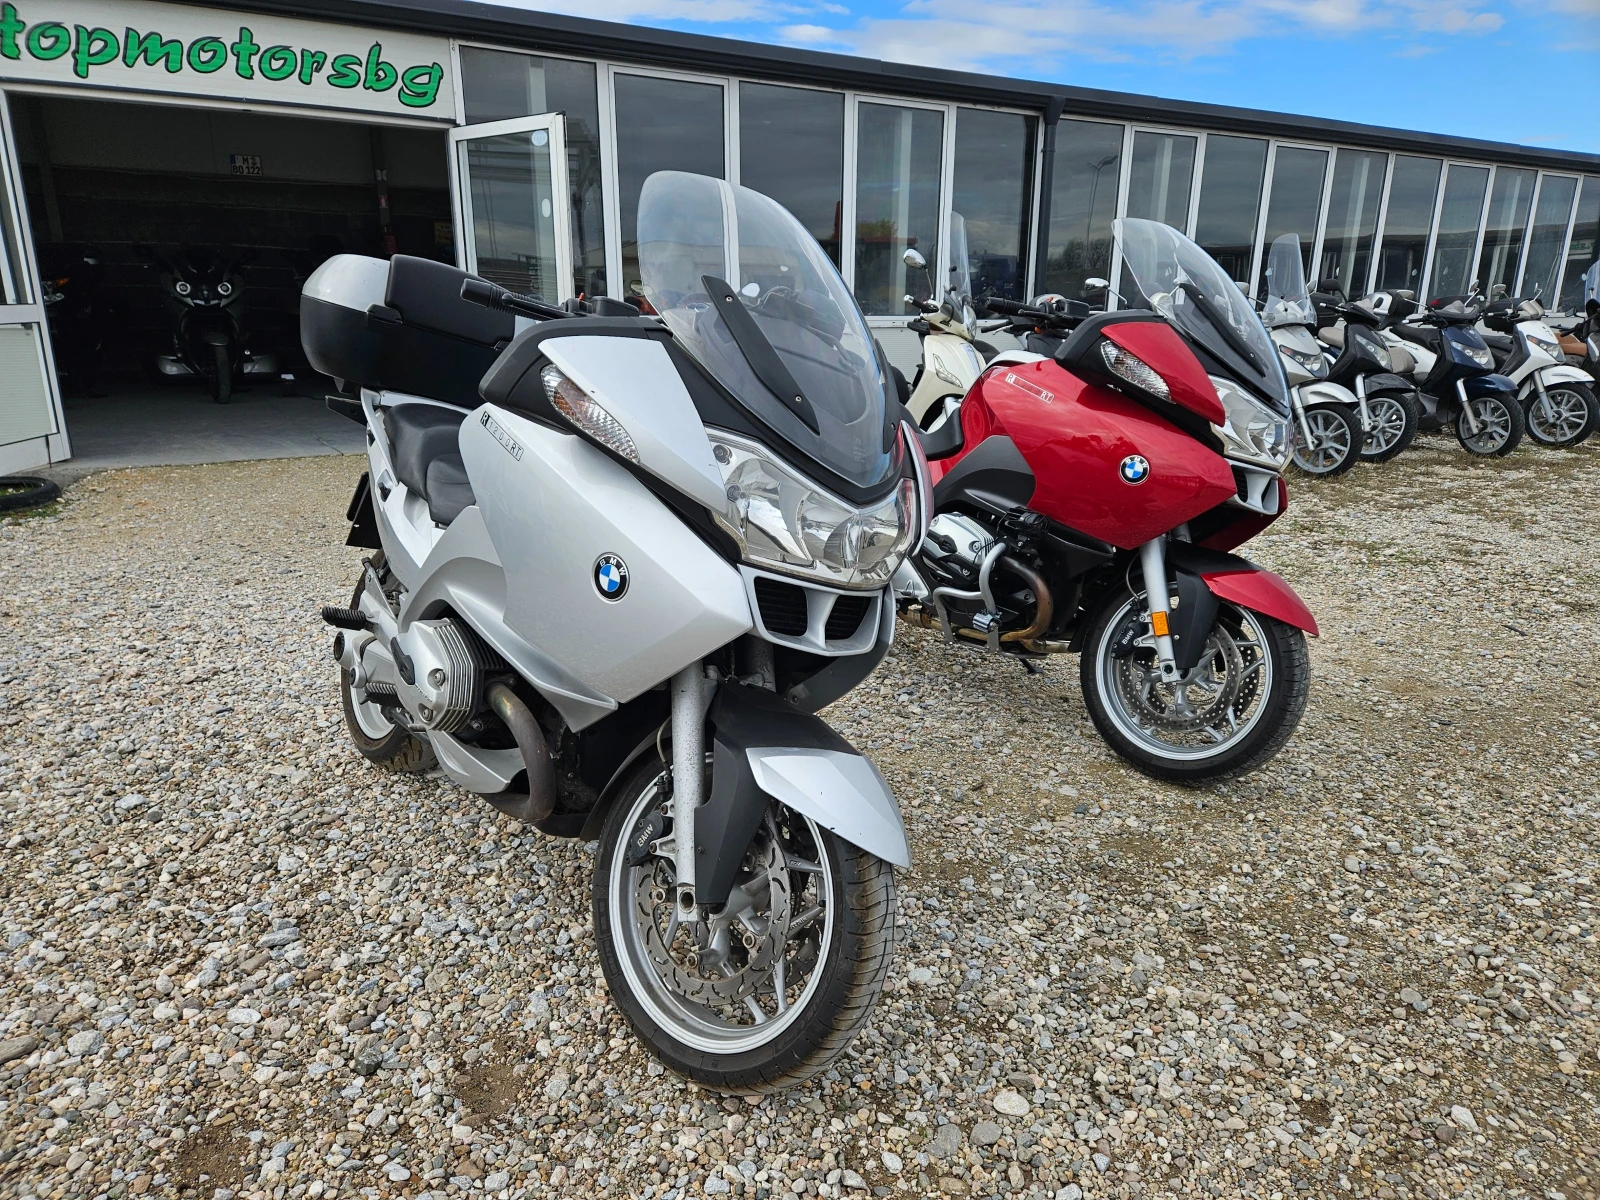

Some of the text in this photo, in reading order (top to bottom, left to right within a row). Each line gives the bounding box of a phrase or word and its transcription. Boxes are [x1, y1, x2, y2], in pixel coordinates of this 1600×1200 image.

[0, 2, 444, 107] topmotorsbg
[245, 165, 261, 175] 122
[600, 556, 626, 576] BMW
[1121, 629, 1135, 645] BMW
[637, 823, 654, 848] BMW
